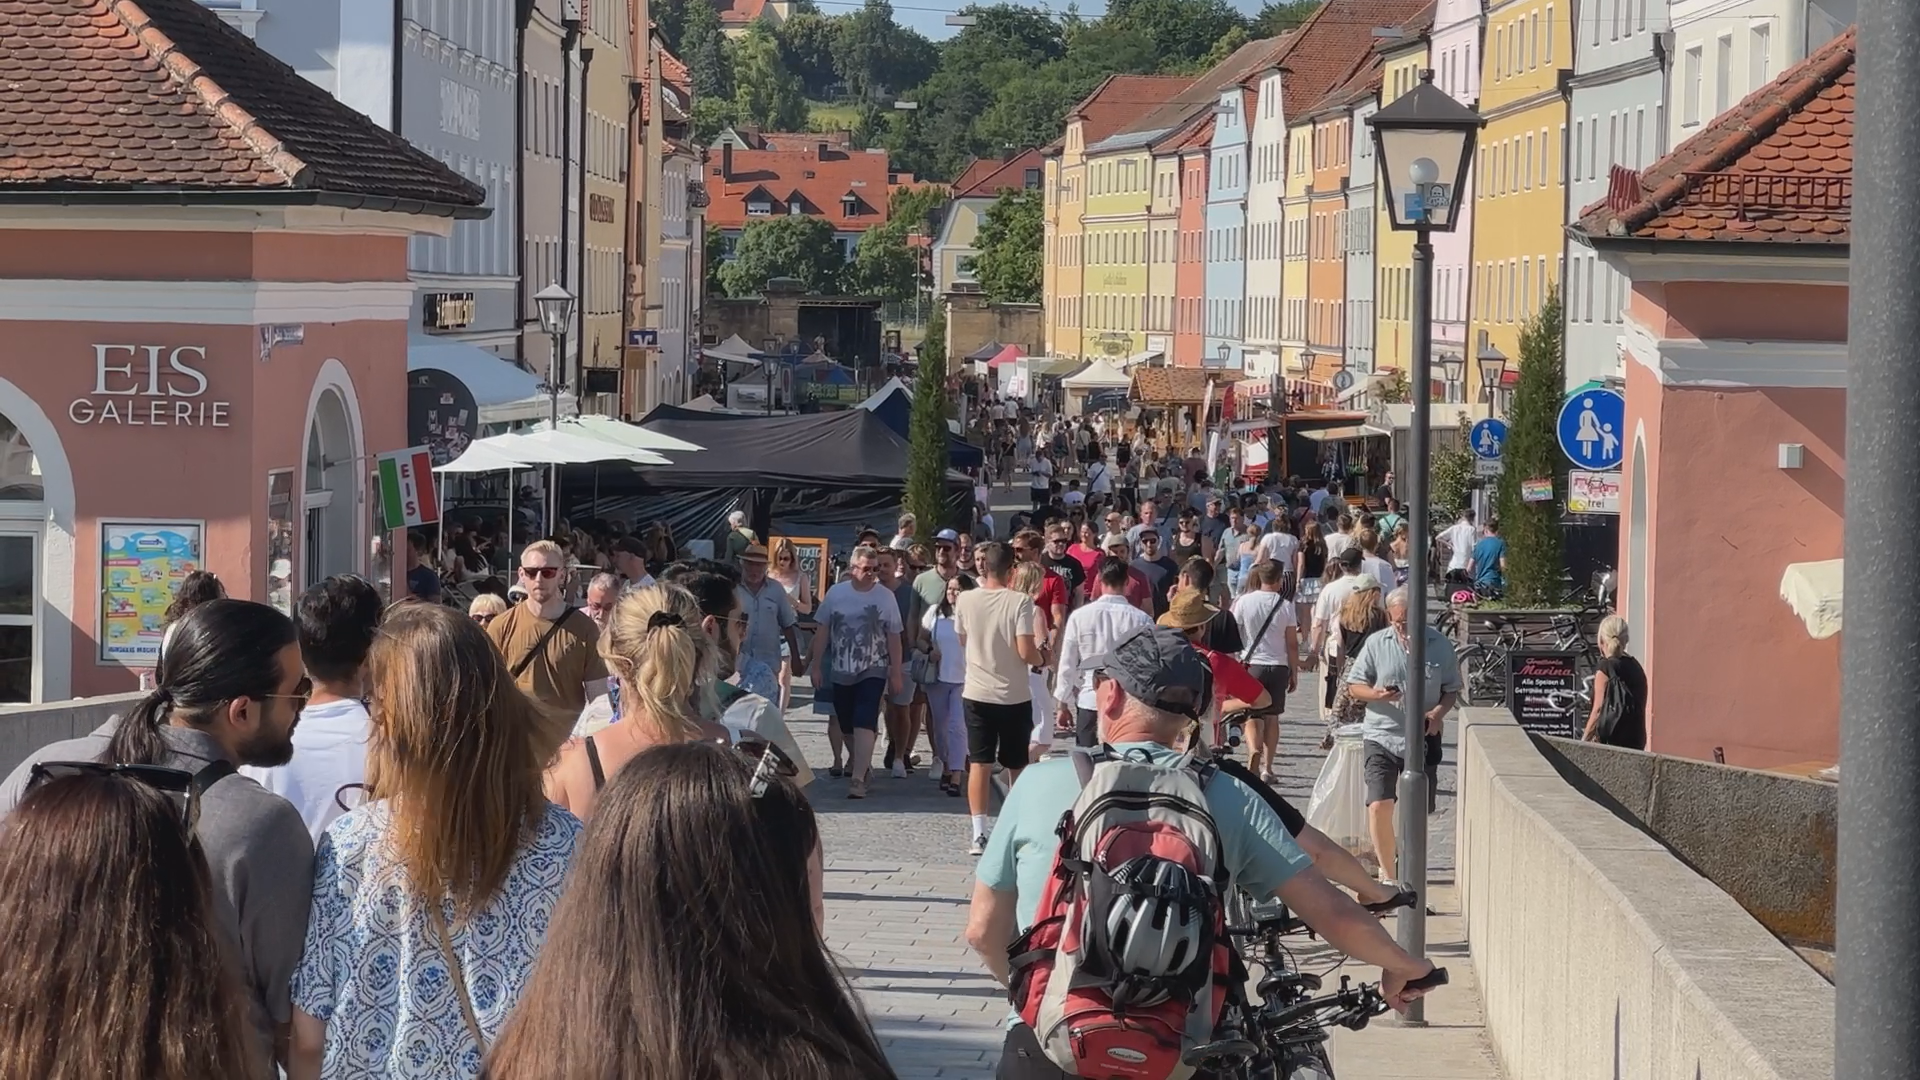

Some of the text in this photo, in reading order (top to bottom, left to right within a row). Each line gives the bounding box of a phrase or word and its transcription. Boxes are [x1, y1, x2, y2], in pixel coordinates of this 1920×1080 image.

[91, 344, 207, 397] EIS
[69, 398, 229, 427] GALERIE
[401, 463, 416, 516] EIS
[1588, 499, 1604, 508] frei
[800, 558, 816, 572] GO
[1519, 665, 1571, 676] Marina
[1535, 678, 1559, 687] Speisen
